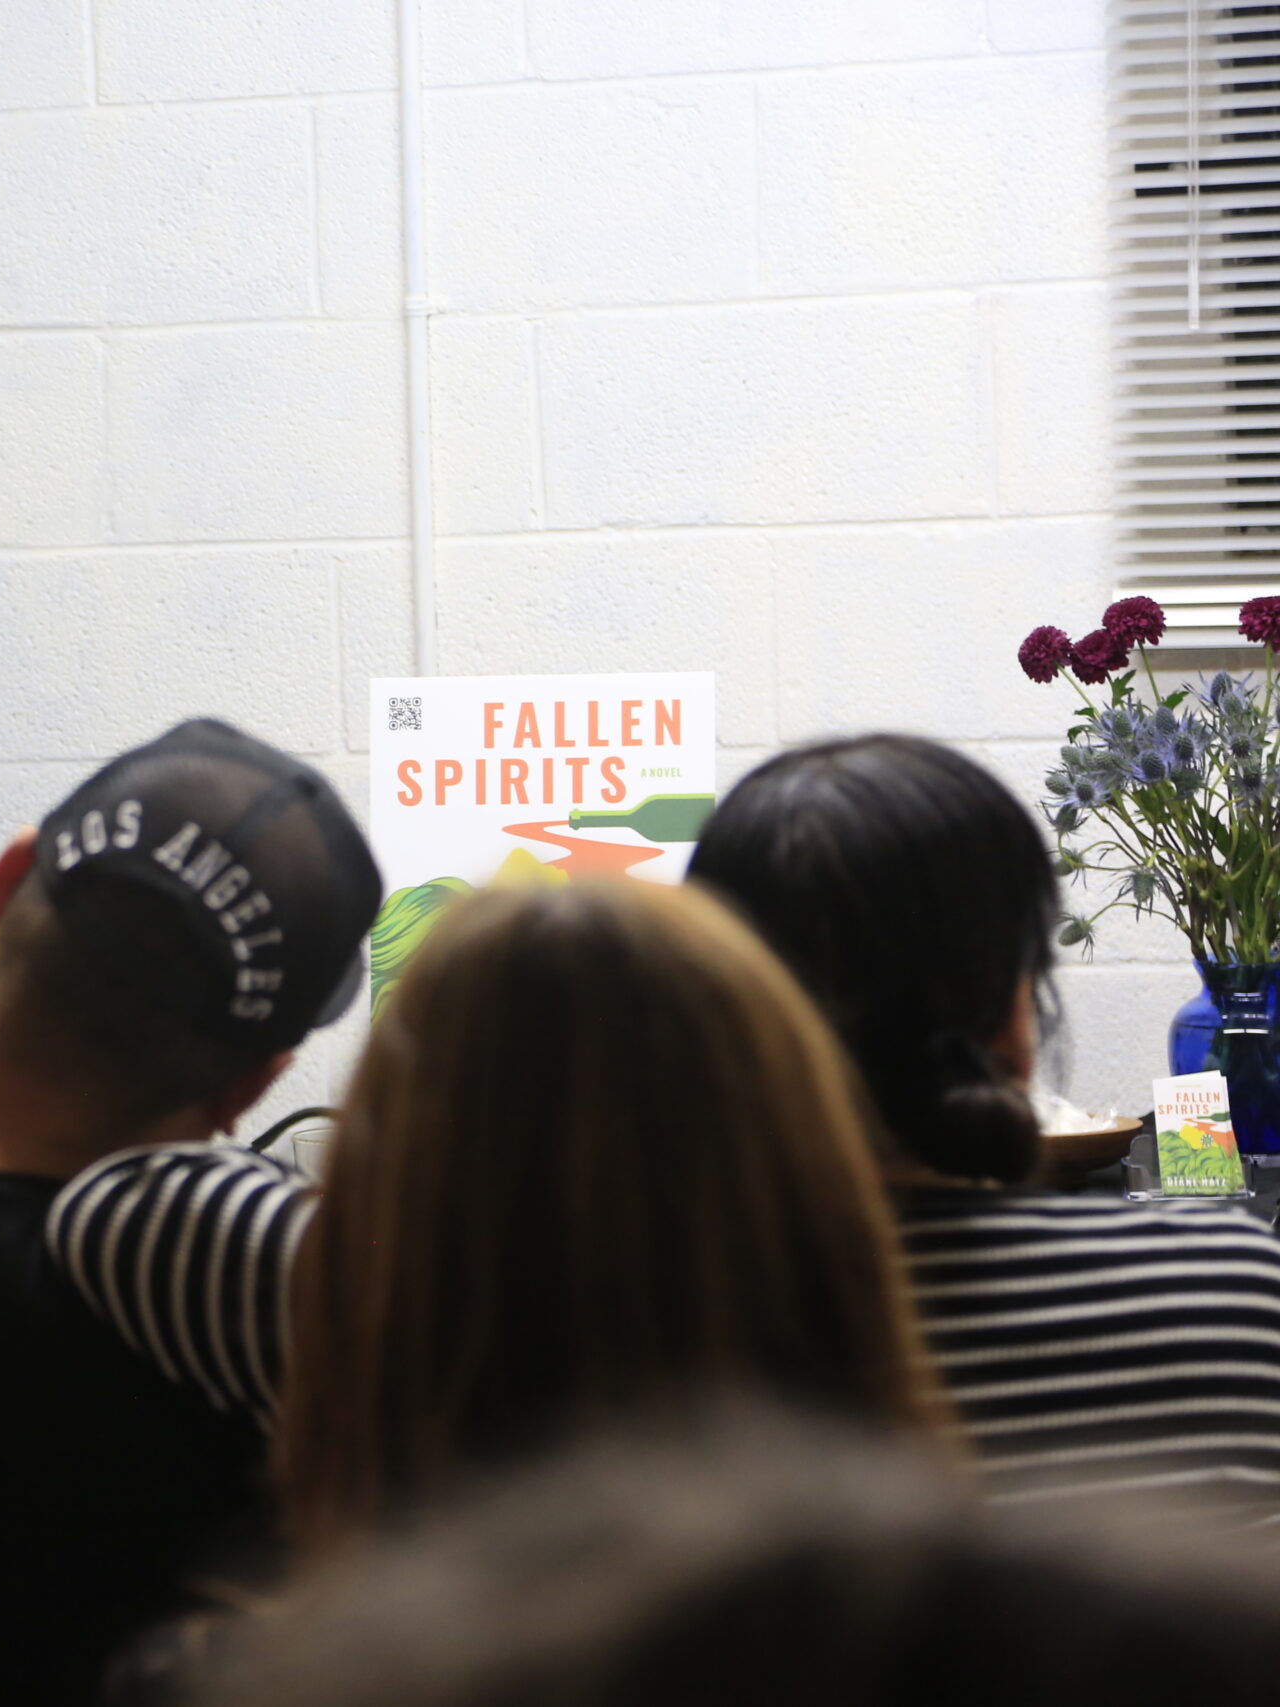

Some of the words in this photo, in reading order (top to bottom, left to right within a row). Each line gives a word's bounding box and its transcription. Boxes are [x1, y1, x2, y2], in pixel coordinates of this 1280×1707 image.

[483, 699, 682, 749] FALLEN
[397, 756, 627, 807] SPIRITS
[640, 767, 648, 778] A
[649, 767, 682, 778] NOVEL
[55, 799, 143, 871] LOS
[152, 821, 284, 1020] ANGELES
[1158, 1104, 1210, 1115] SPIRITS
[1176, 1092, 1221, 1103] FALLEN
